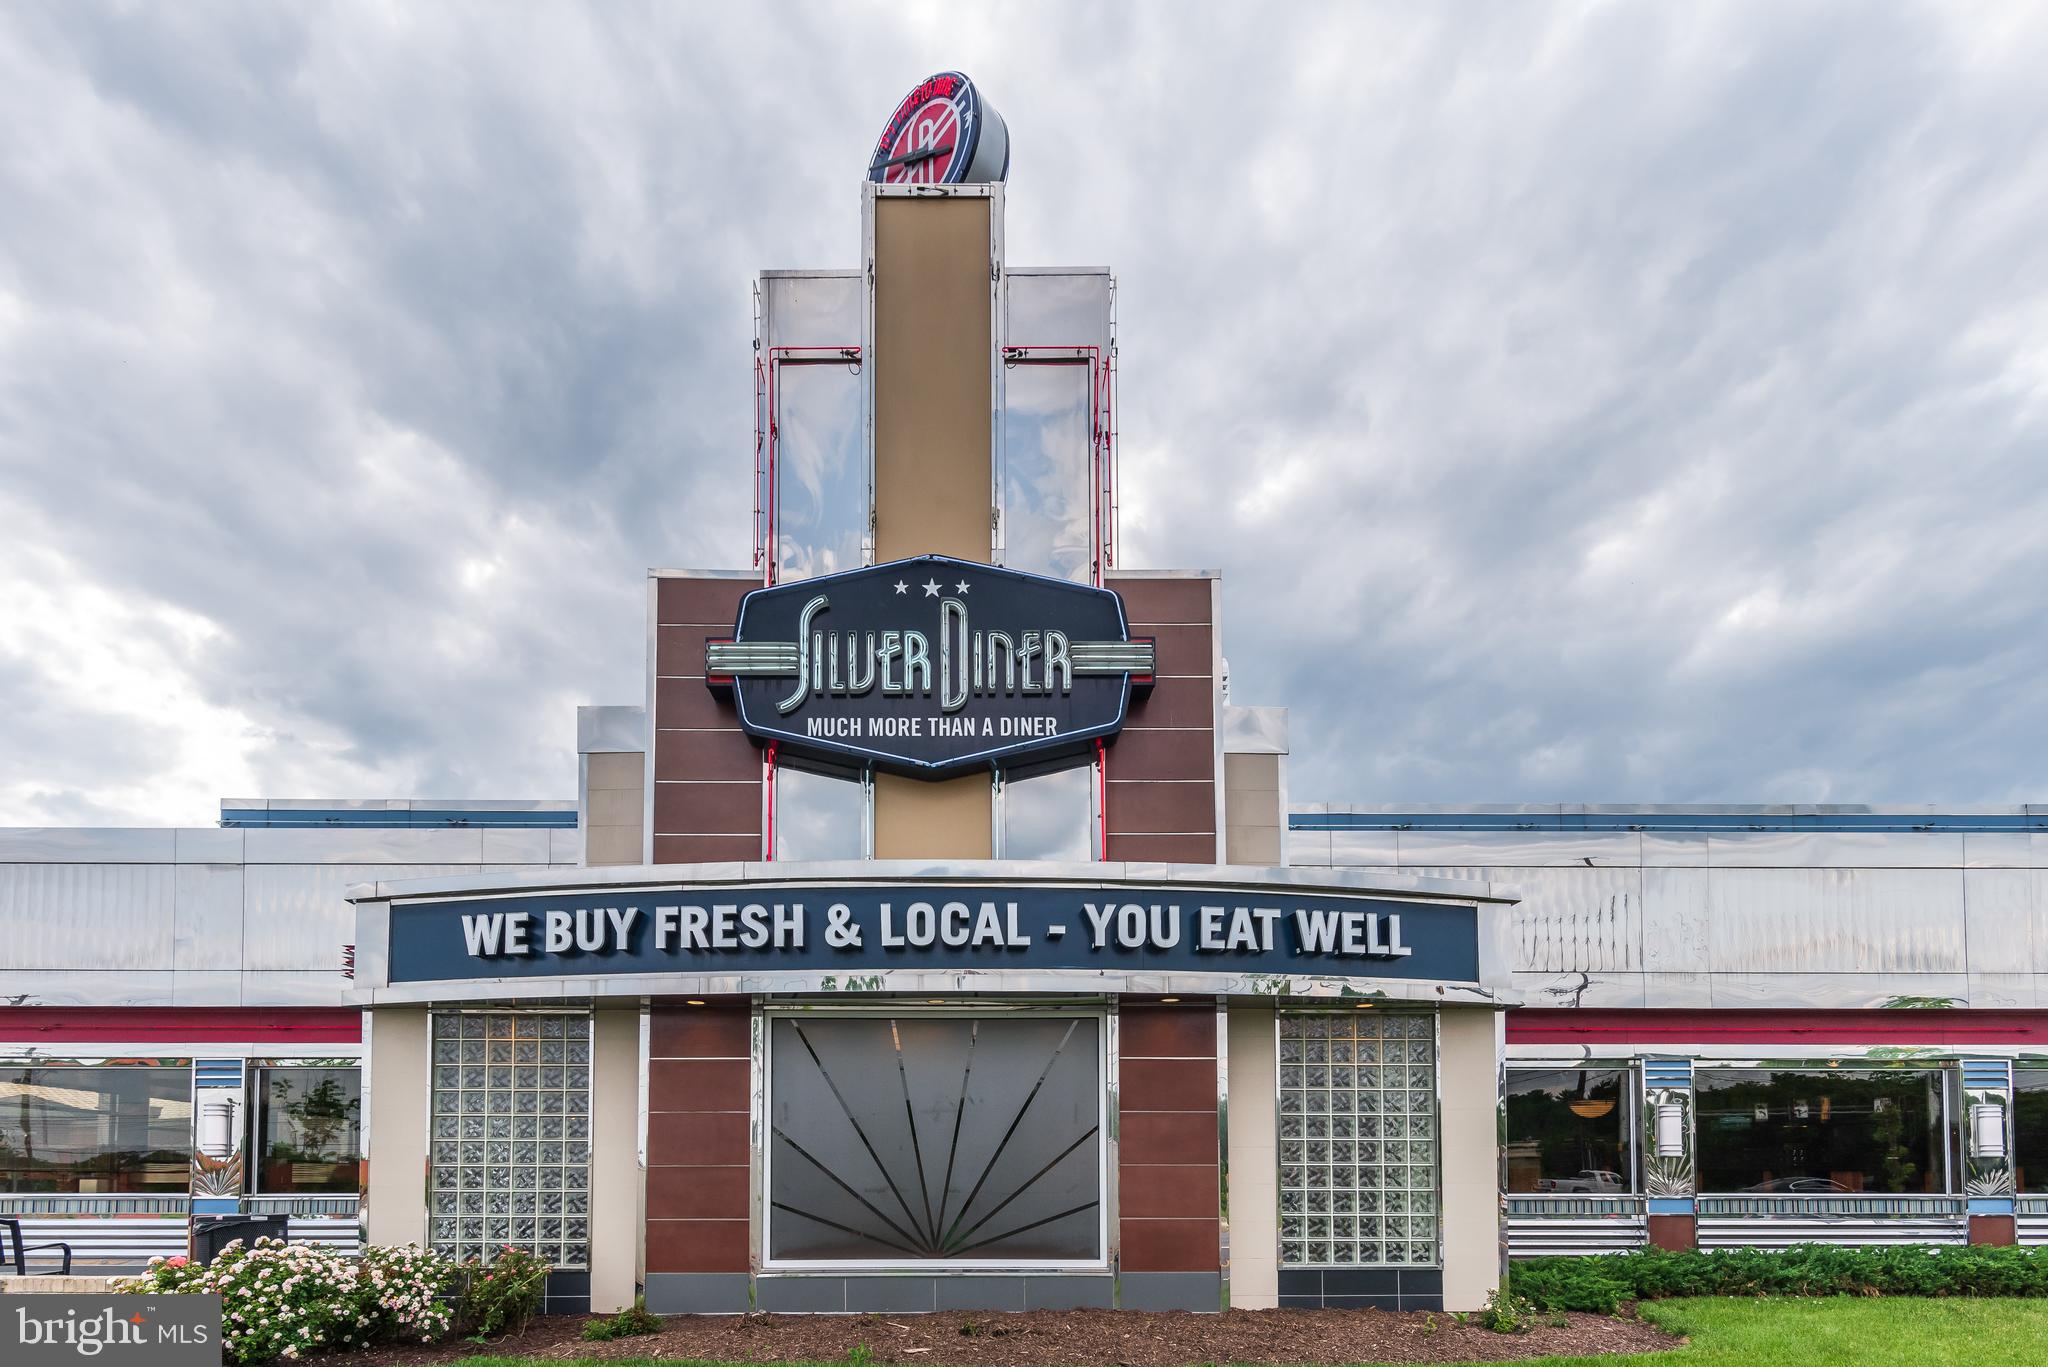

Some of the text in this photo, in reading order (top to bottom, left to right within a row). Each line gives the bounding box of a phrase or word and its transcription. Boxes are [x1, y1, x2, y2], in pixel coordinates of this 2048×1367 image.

[920, 81, 933, 102] TO
[807, 717, 1057, 737] MUCH MORE THAN A DINER
[462, 902, 1411, 955] WE BUY FRESH & LOCAL - YOU EAT WELL
